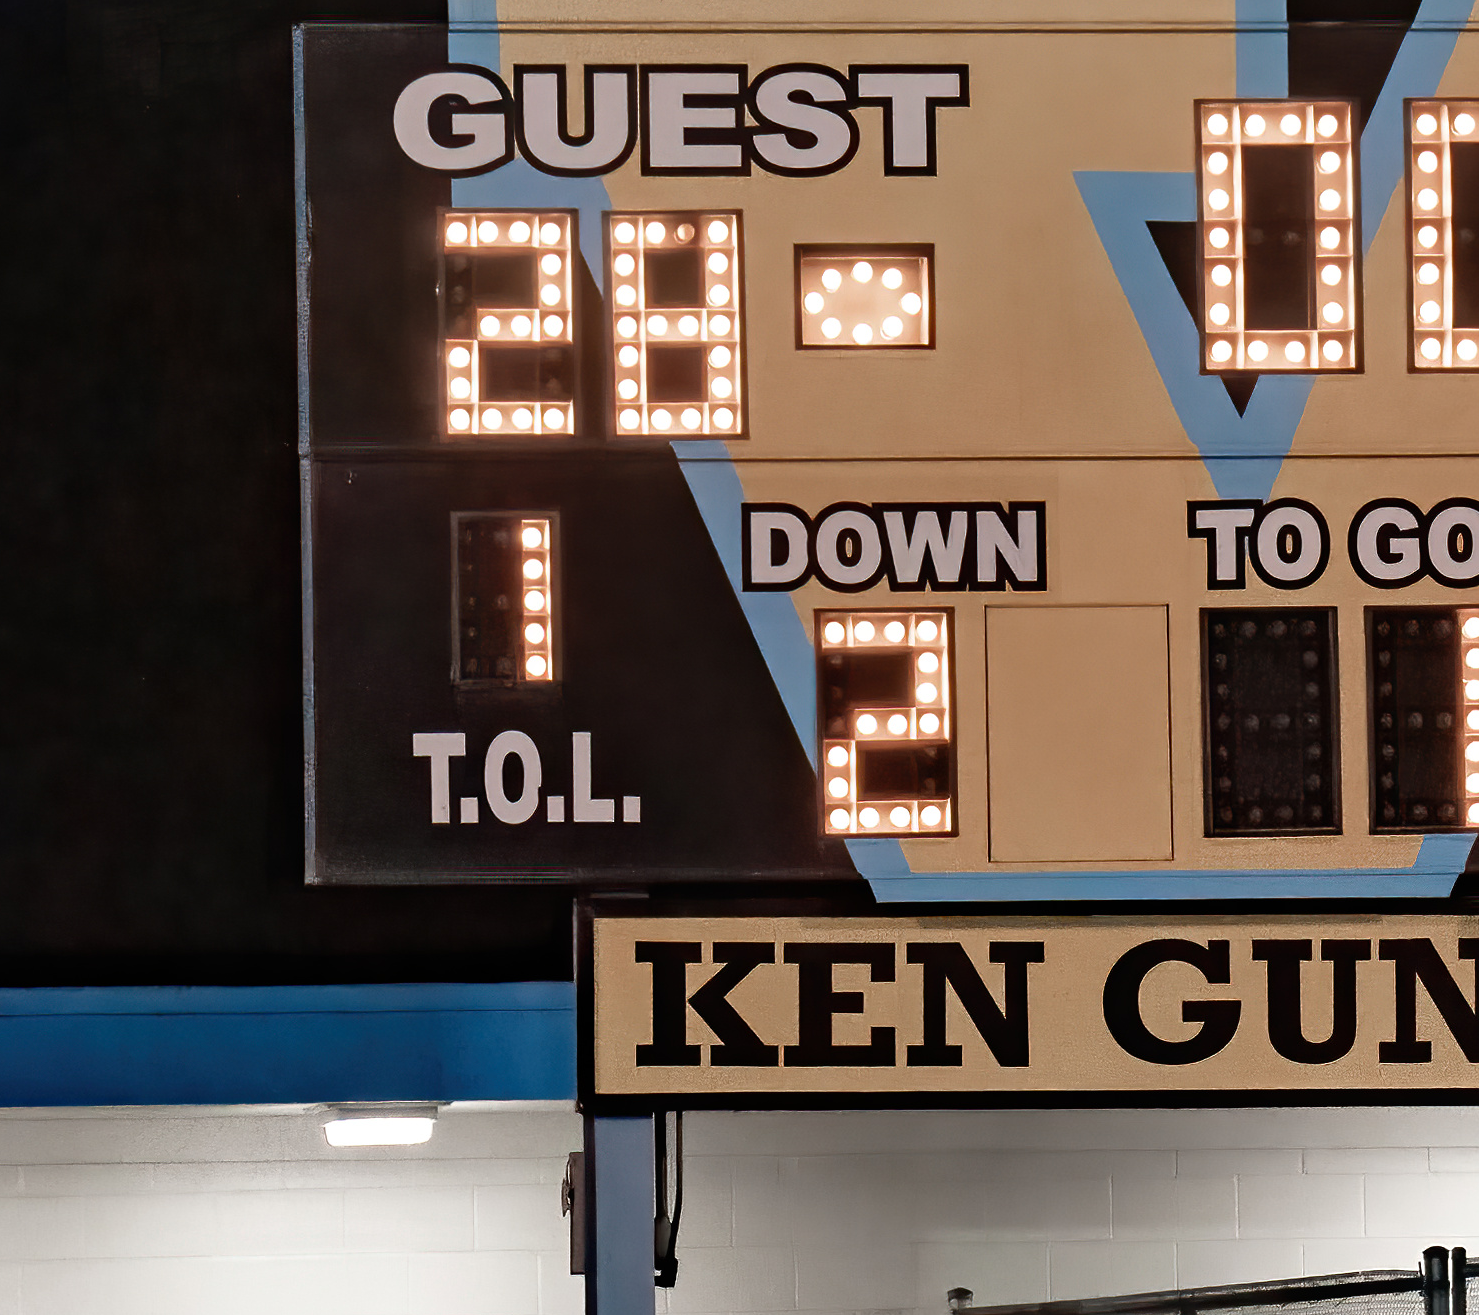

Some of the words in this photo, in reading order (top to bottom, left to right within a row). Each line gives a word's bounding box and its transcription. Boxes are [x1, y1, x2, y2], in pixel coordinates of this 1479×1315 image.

[393, 62, 970, 178] GUEST
[442, 212, 745, 438] 28
[520, 518, 552, 682] 1
[741, 501, 1047, 593] DOWN
[1187, 498, 1331, 590] TO
[413, 730, 642, 824] T.O.L.
[819, 611, 955, 835] 2
[633, 939, 1045, 1068] KEN
